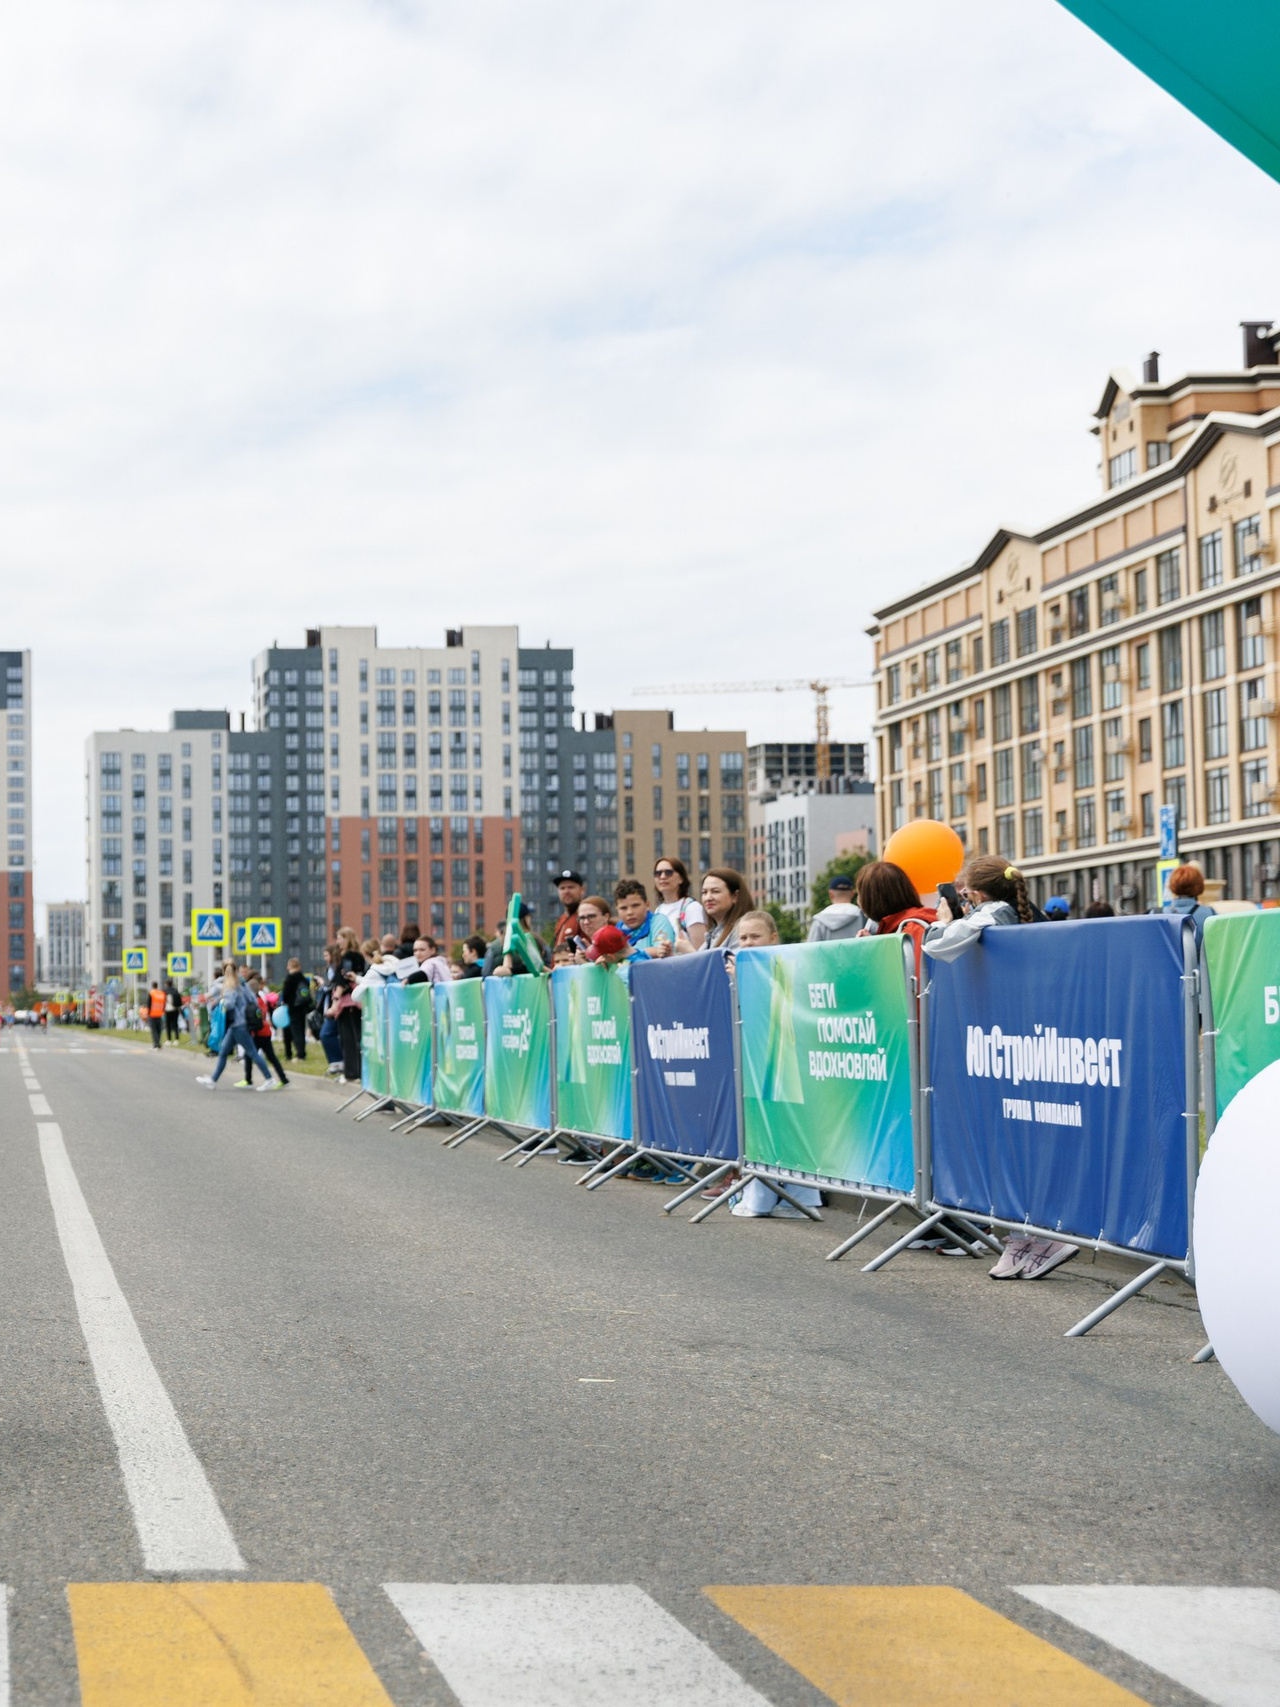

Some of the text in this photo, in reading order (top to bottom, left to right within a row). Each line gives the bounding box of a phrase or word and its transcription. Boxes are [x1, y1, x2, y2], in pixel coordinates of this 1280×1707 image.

[808, 983, 837, 1009] БЕГИ
[1264, 986, 1280, 1025] Б
[817, 1011, 876, 1044] ПОМОГАЙ
[808, 1047, 887, 1082] ВДОХНОВЛЯЙ
[966, 1023, 1122, 1087] ЮгСтройИнвест
[1002, 1098, 1082, 1127] ГРУППА КОМПАНИЙ
